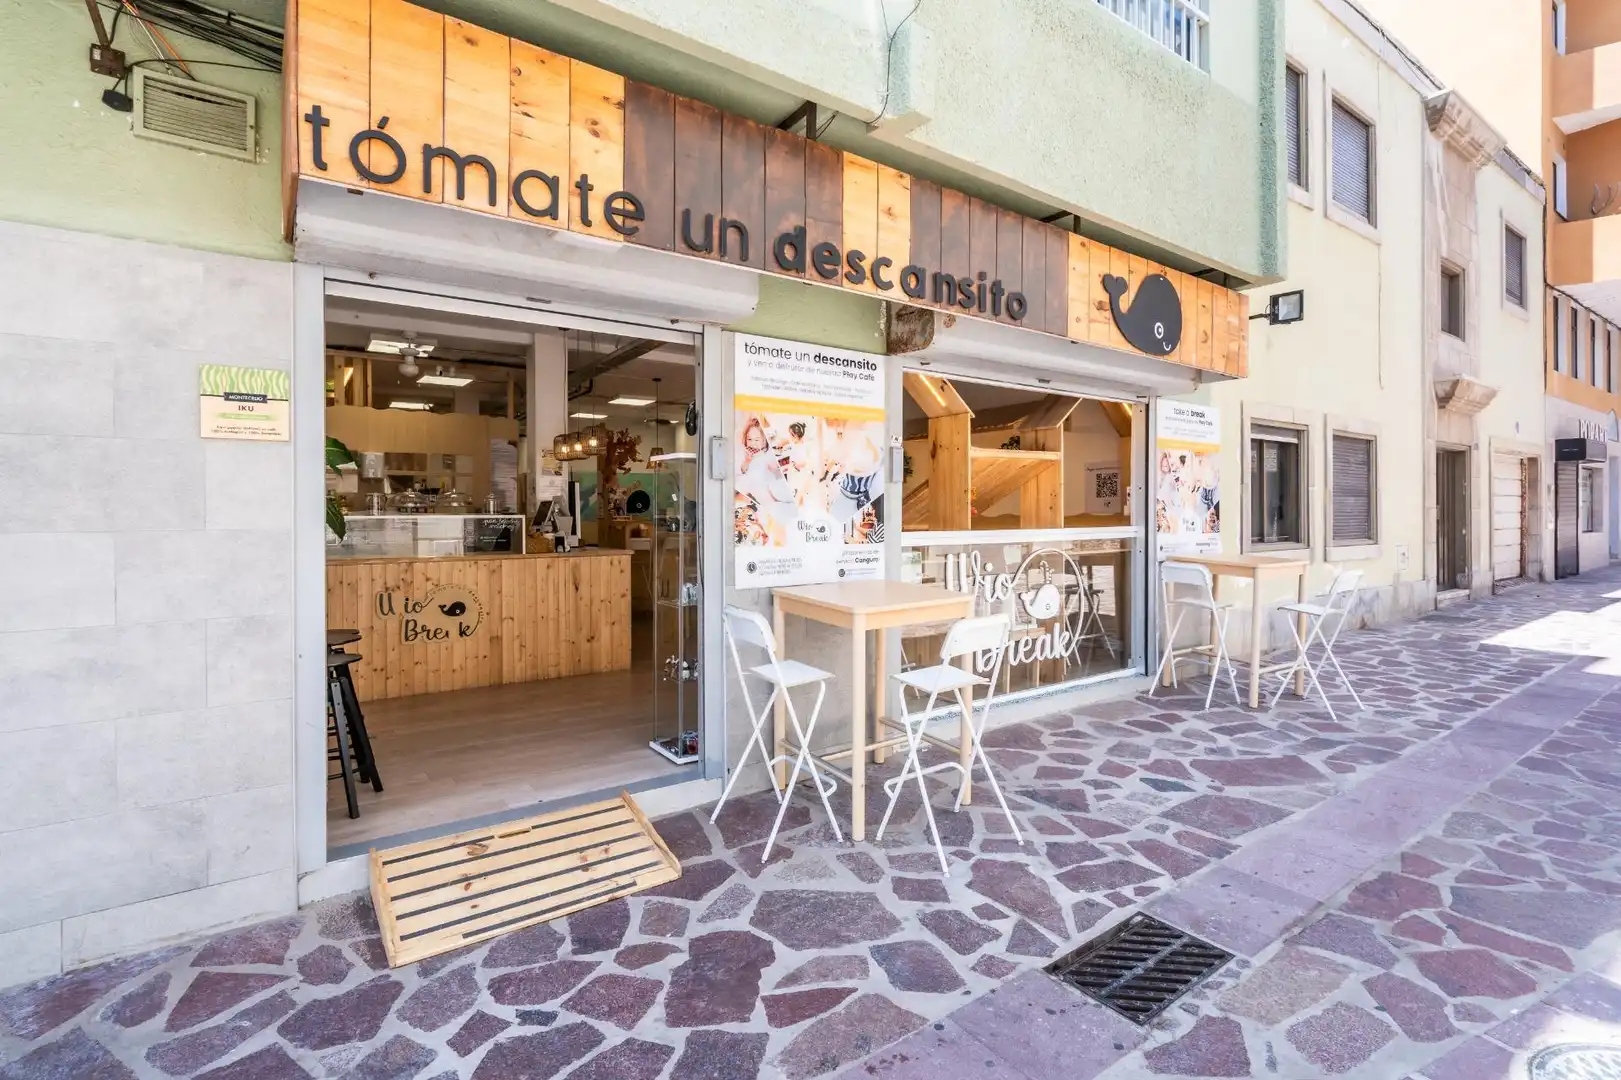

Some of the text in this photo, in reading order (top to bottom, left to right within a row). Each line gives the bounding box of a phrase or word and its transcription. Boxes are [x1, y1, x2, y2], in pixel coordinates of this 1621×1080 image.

[304, 104, 1028, 321] tómate un descansito
[744, 342, 877, 371] tómate un descansito
[842, 370, 857, 380] Play
[238, 404, 254, 412] IKU
[1191, 409, 1205, 418] break
